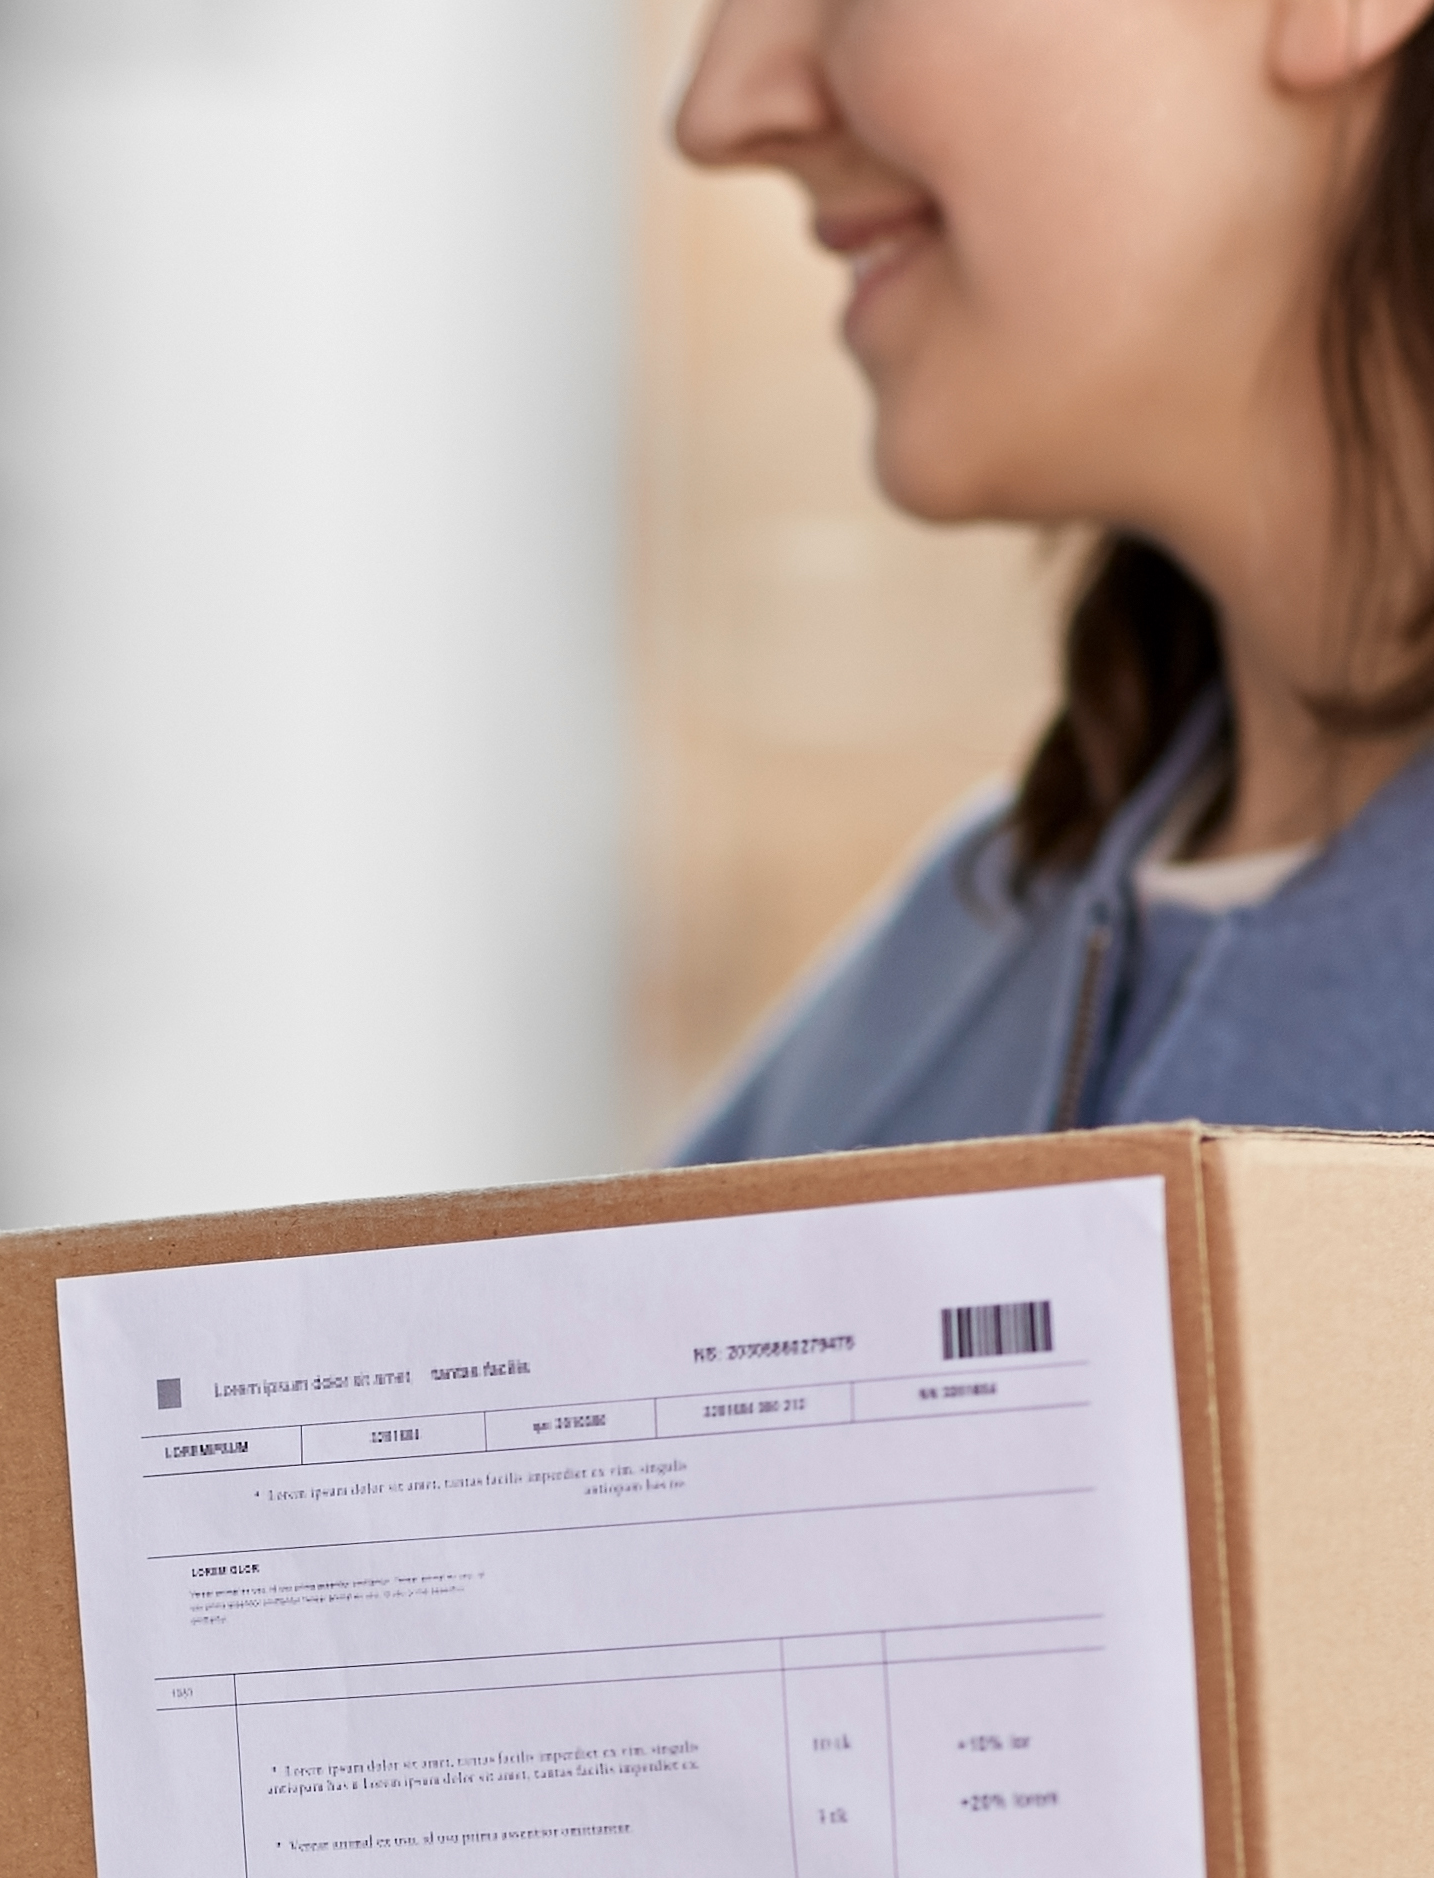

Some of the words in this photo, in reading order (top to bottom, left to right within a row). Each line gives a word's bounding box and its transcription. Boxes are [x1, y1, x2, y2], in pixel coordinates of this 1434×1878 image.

[213, 1382, 262, 1399] Lorem
[262, 1378, 309, 1398] ipsum
[311, 1374, 349, 1391] dolor
[267, 1489, 307, 1502] Lorem
[310, 1486, 348, 1502] ipsum
[350, 1481, 385, 1496] dolor
[485, 1471, 523, 1487] facilis
[284, 1764, 323, 1777] Lorem
[327, 1763, 366, 1778] ipsum
[366, 1758, 399, 1773] dolor
[497, 1749, 535, 1765] facilis
[362, 1776, 402, 1790] Lorem
[403, 1776, 441, 1790] ipsum
[442, 1771, 474, 1785] dolor
